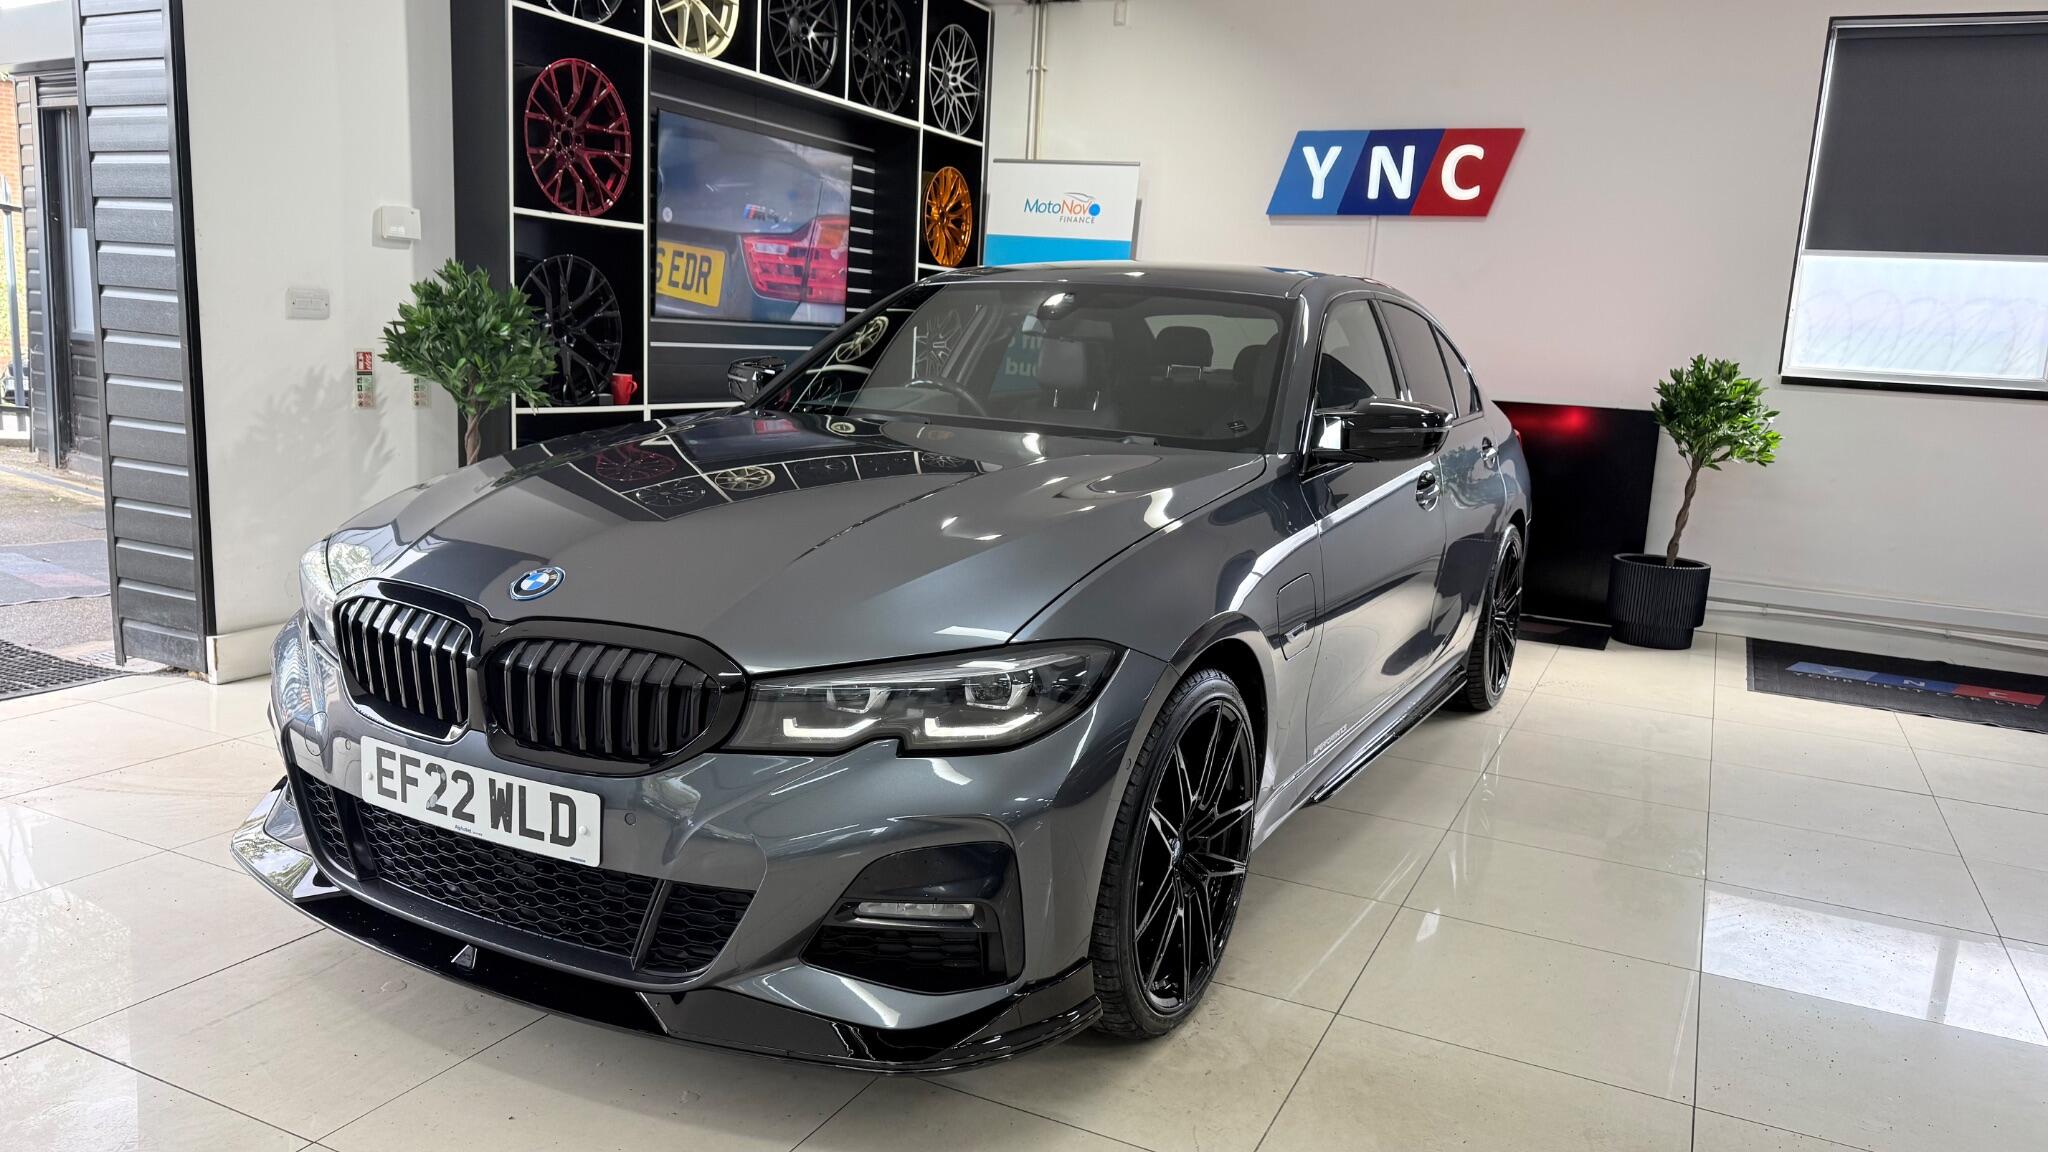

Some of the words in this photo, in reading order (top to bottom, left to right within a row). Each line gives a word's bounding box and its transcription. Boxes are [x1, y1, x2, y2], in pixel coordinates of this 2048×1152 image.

[1302, 144, 1485, 200] YNC
[1059, 215, 1095, 224] FINANCE
[668, 249, 713, 295] EDR
[376, 747, 476, 824] EF22
[488, 777, 577, 848] WLD
